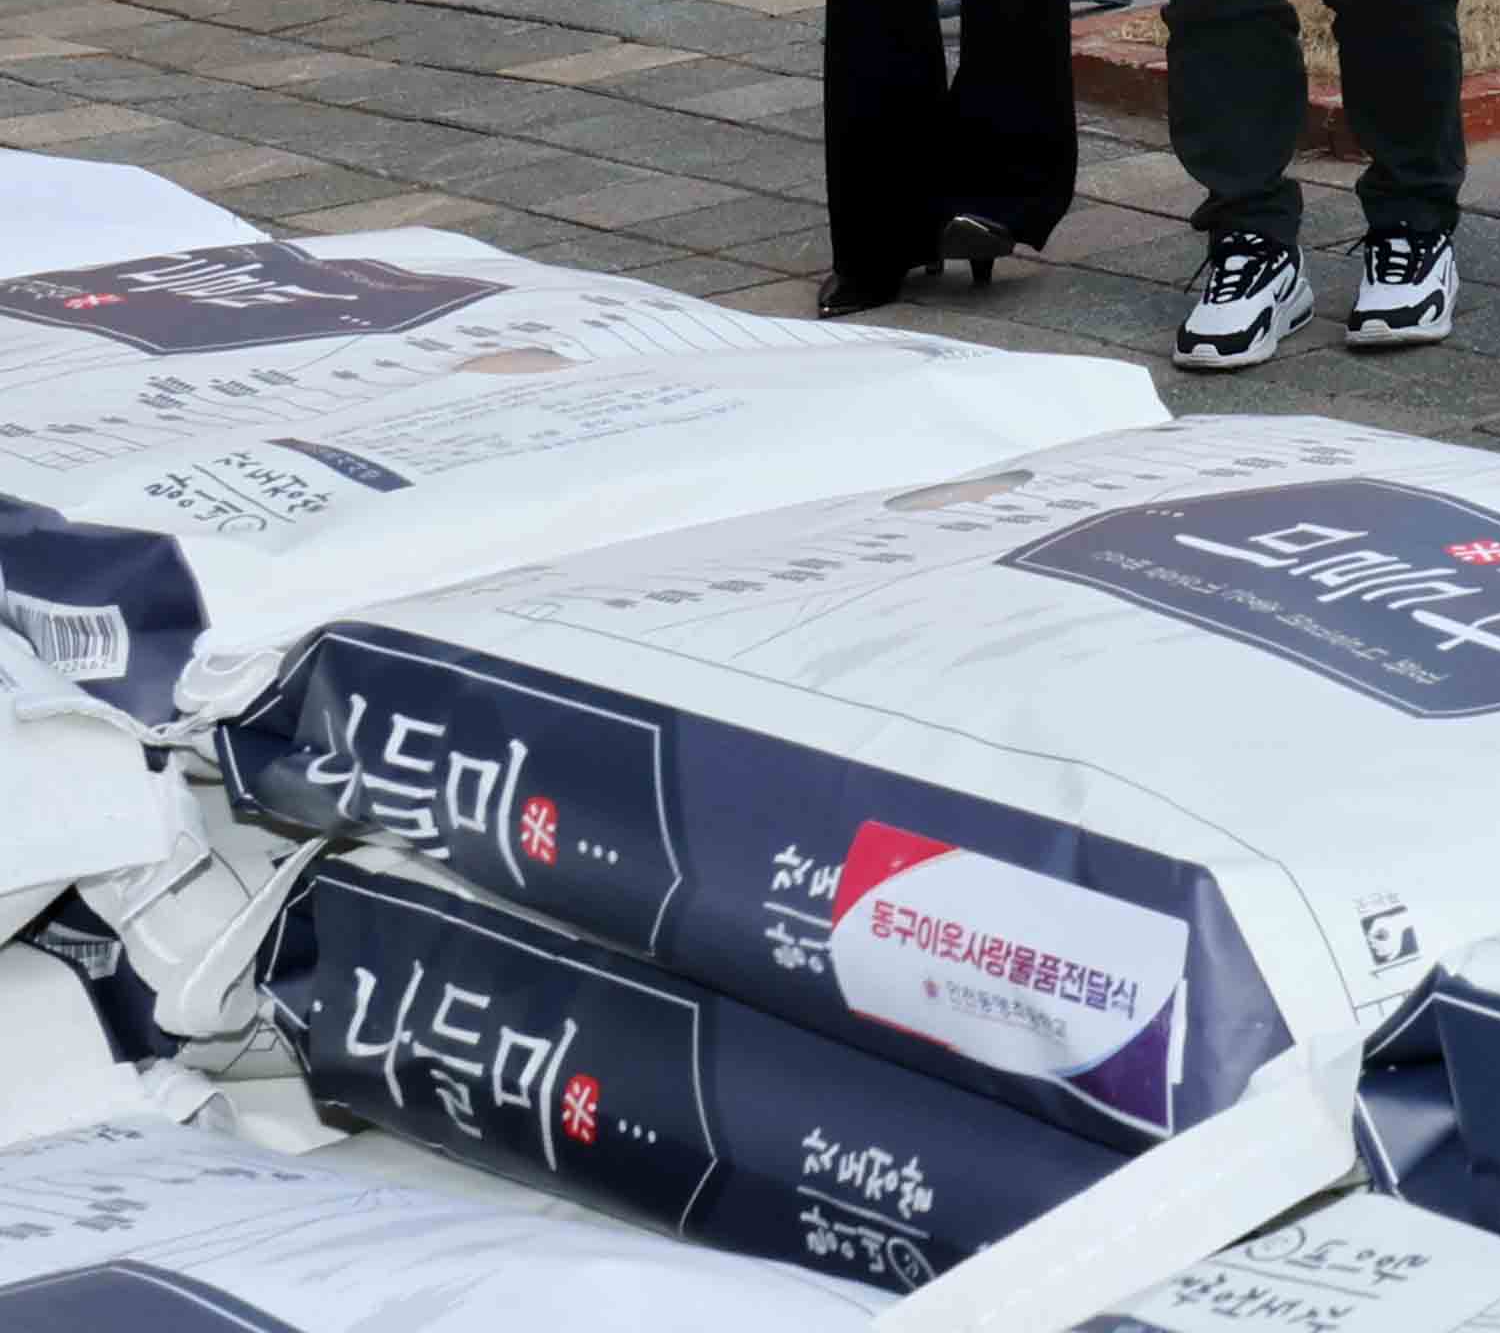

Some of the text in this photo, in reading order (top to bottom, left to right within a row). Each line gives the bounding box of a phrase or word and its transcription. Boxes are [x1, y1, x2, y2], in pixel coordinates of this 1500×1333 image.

[304, 692, 528, 890] 나들미
[870, 899, 1140, 1021] 동구이웃사랑물품전달식
[345, 959, 578, 1172] 나들미
